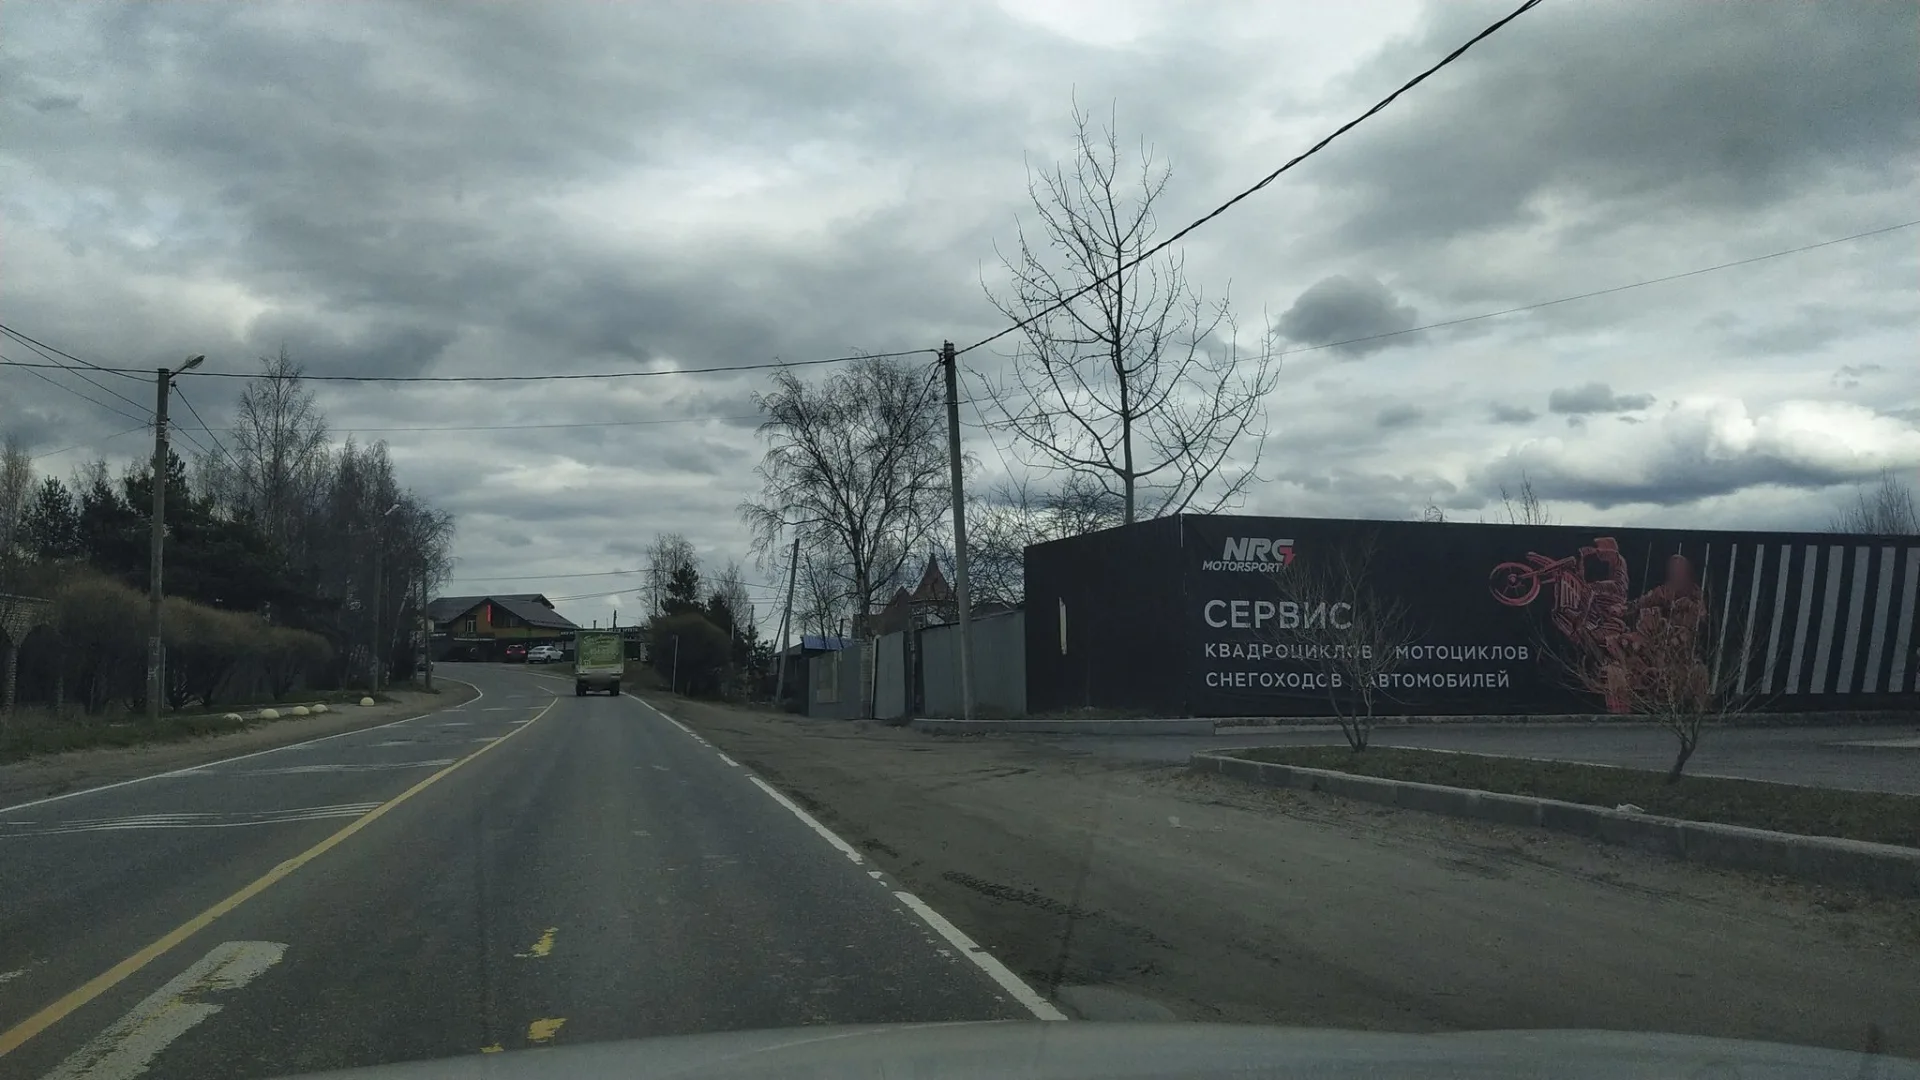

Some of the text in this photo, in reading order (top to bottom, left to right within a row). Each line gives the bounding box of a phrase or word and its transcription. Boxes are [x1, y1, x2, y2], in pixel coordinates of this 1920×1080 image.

[1223, 537, 1296, 564] NRG
[1202, 560, 1282, 573] MOTORSPORT
[1204, 599, 1352, 630] СЕРВИС
[1396, 646, 1529, 662] МОТОЦИКЛОВ
[1206, 672, 1343, 690] СНЕГОХОДОВ
